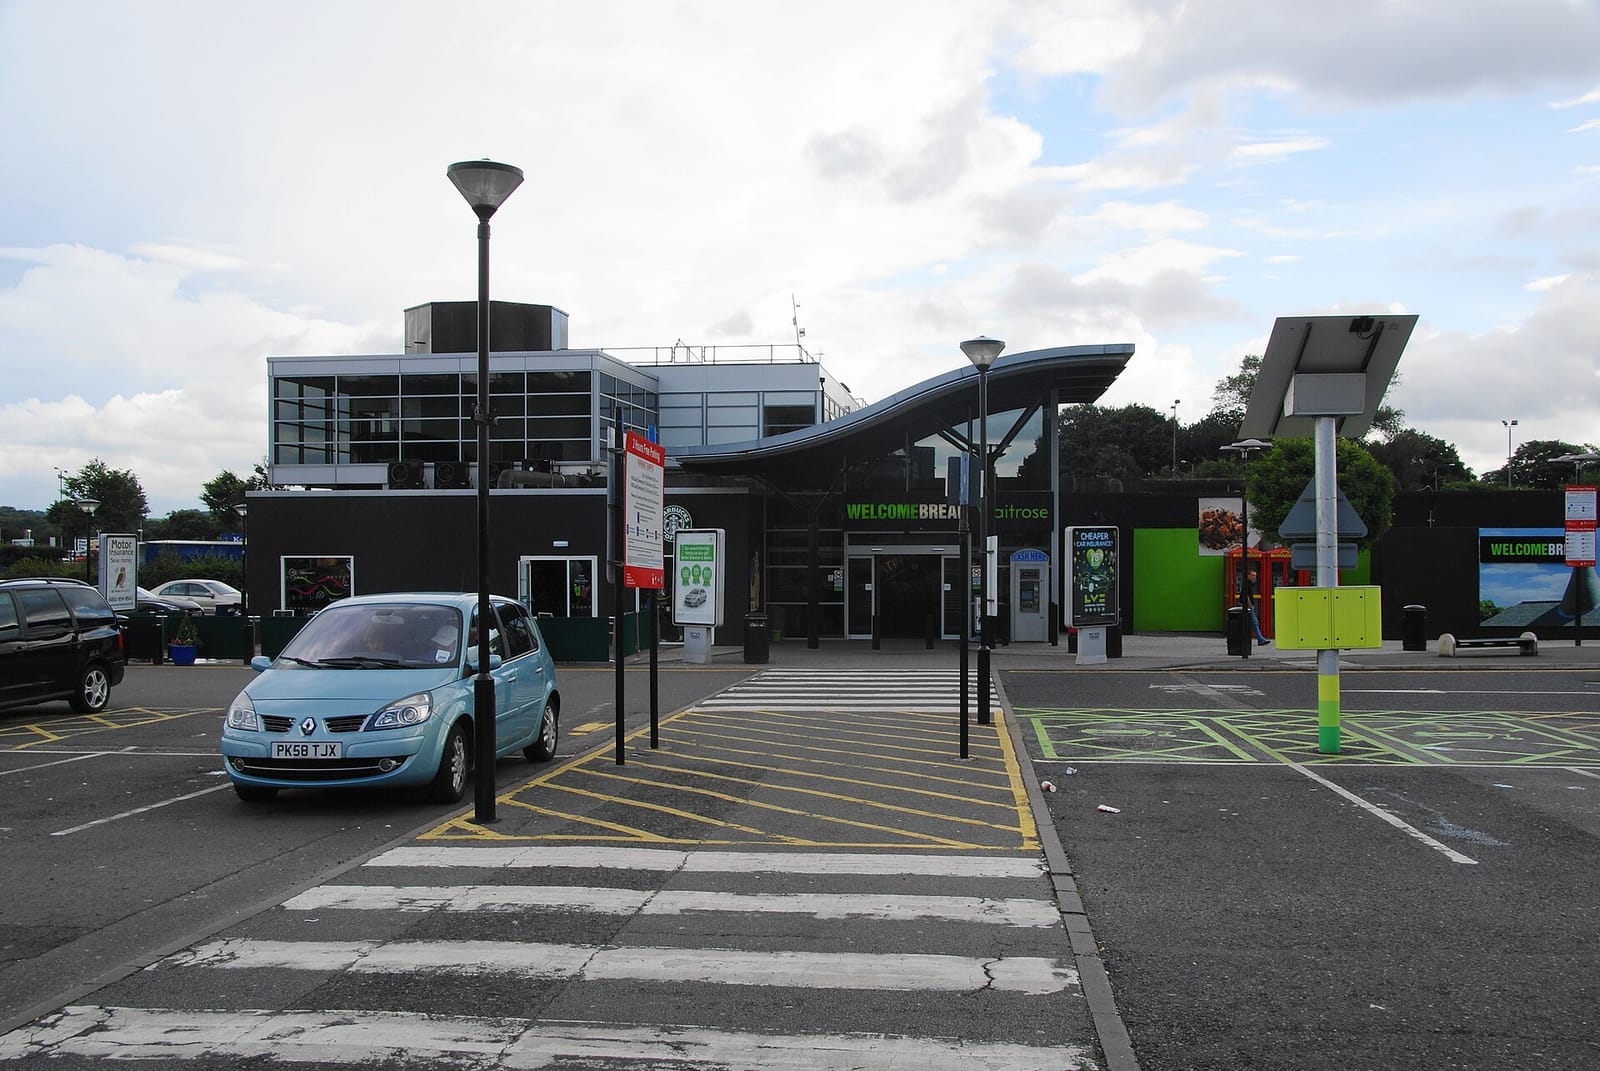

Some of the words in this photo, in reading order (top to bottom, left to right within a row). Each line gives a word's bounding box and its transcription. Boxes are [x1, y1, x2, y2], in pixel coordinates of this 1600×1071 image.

[977, 505, 1049, 519] aitrose
[1080, 532, 1109, 540] CHEAPER
[112, 539, 132, 549] Motor
[1491, 543, 1566, 556] WELCOMEBR
[277, 744, 308, 757] PK58
[312, 744, 337, 757] TJX
